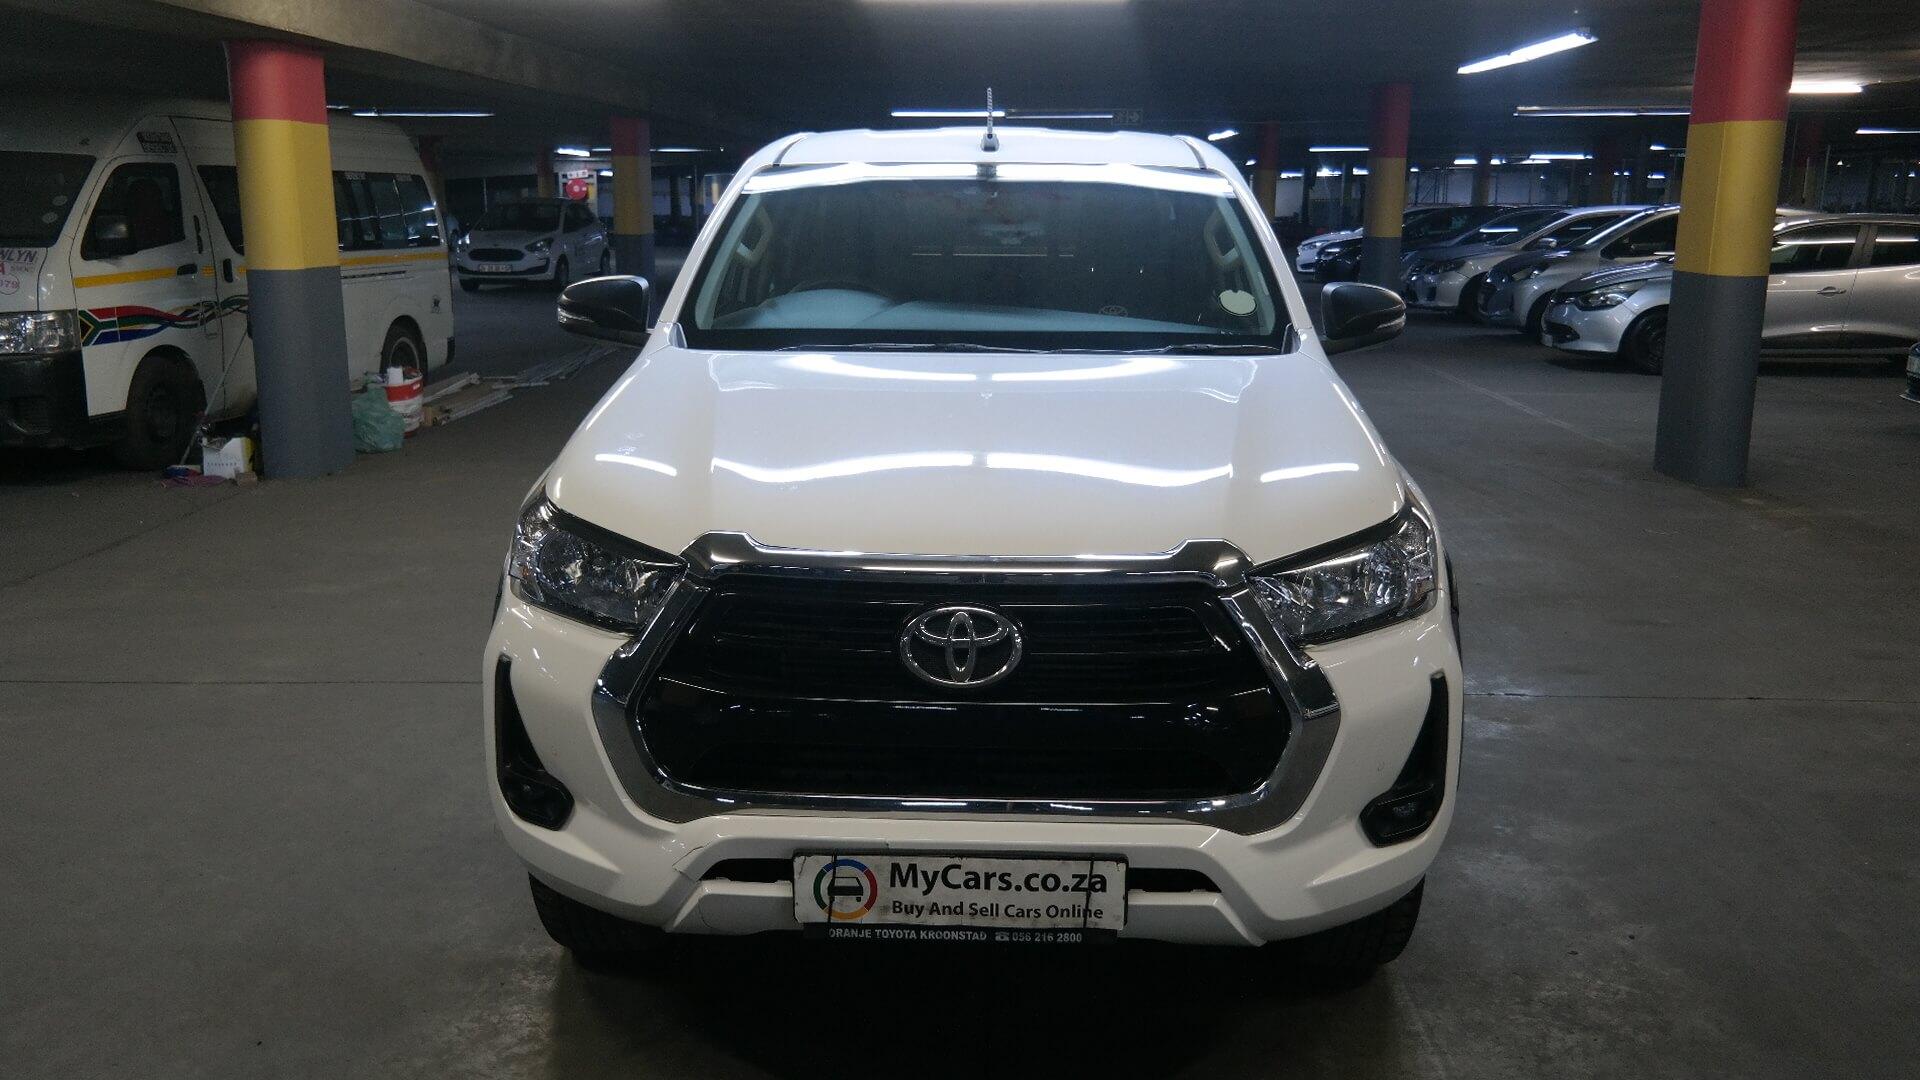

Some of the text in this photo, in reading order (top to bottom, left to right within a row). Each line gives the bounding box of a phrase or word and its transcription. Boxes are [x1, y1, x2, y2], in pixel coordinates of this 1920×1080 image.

[889, 862, 1108, 896] MyCars.co.za
[892, 900, 1104, 919] Buy And Sell Cars Online
[828, 928, 872, 938] ORANJE
[875, 929, 917, 939] TOYOTA
[920, 930, 987, 940] KROONSTAD
[1034, 932, 1054, 942] 216
[1056, 933, 1082, 942] 2800
